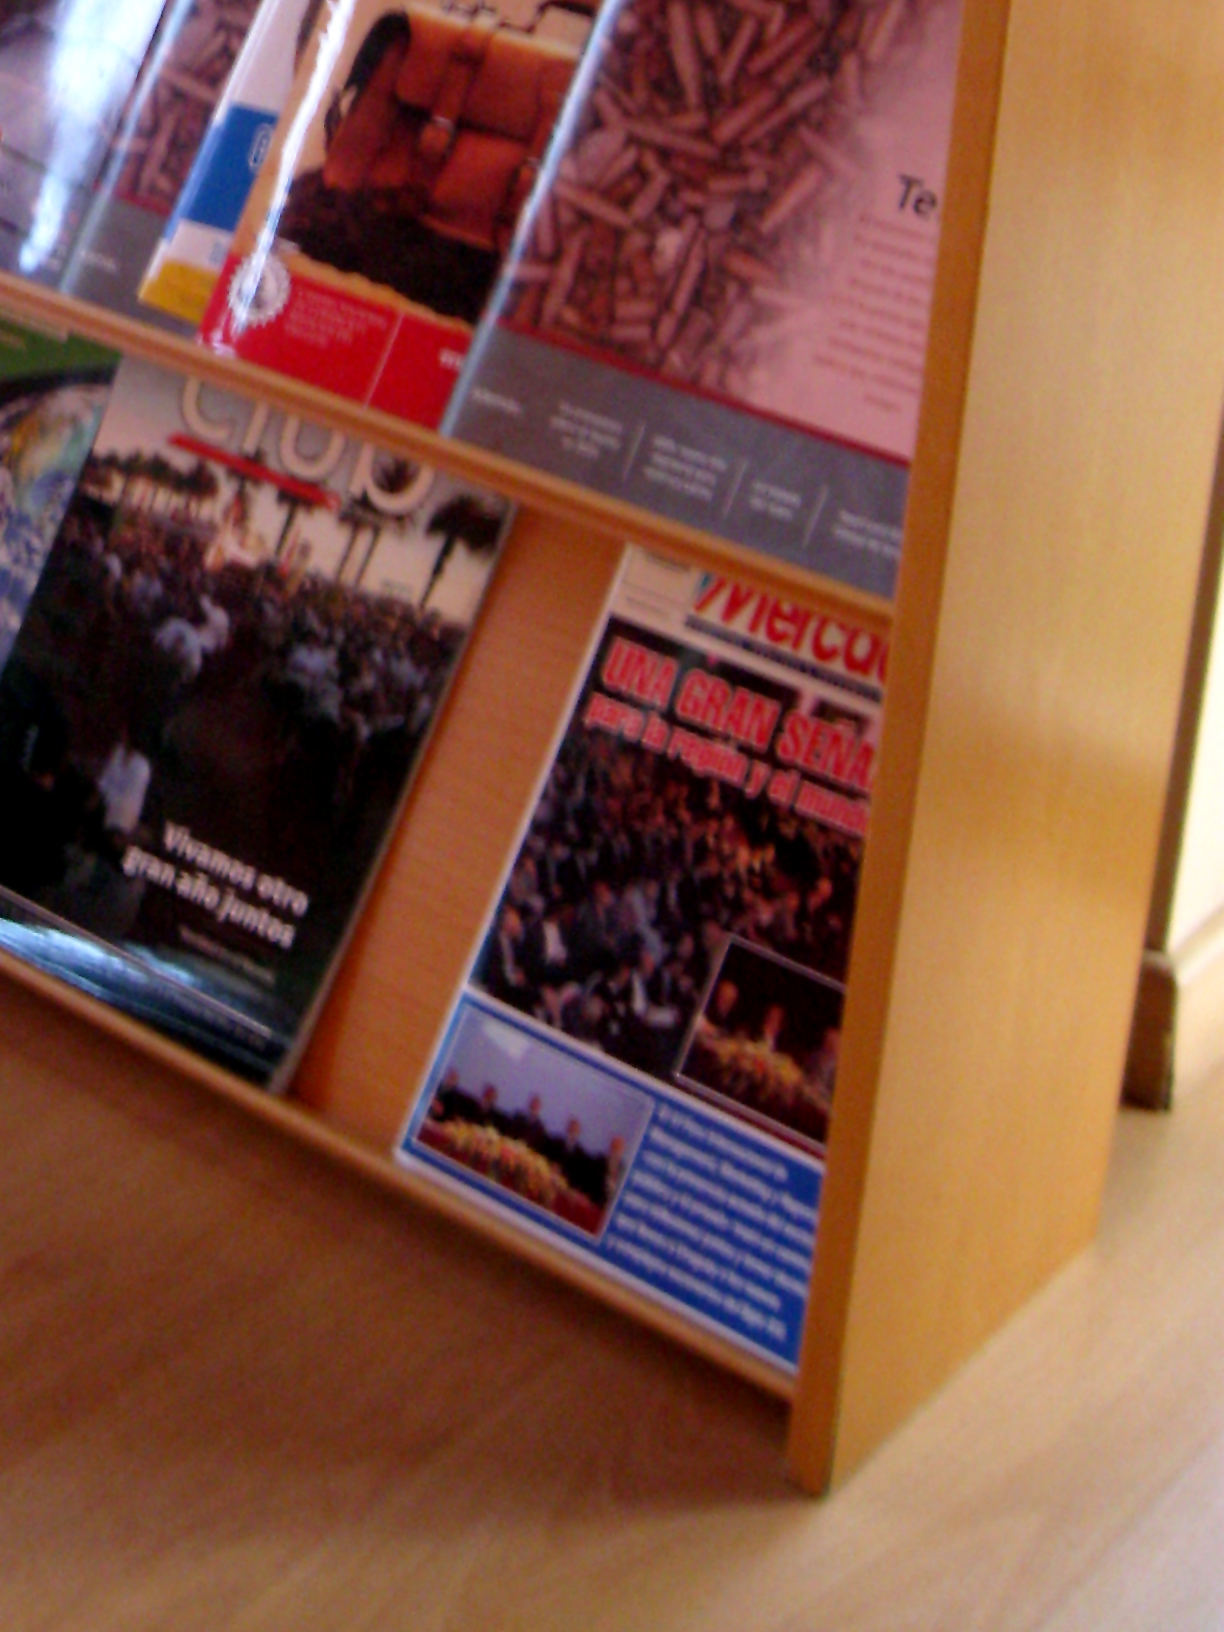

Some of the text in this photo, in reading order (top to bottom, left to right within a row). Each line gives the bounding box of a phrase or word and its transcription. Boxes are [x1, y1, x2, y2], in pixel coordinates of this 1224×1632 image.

[601, 634, 678, 712] UNA
[676, 668, 781, 755] GRAN
[122, 844, 177, 890] gran
[216, 886, 296, 950] juntos
[164, 820, 310, 917] Vivamos otro
